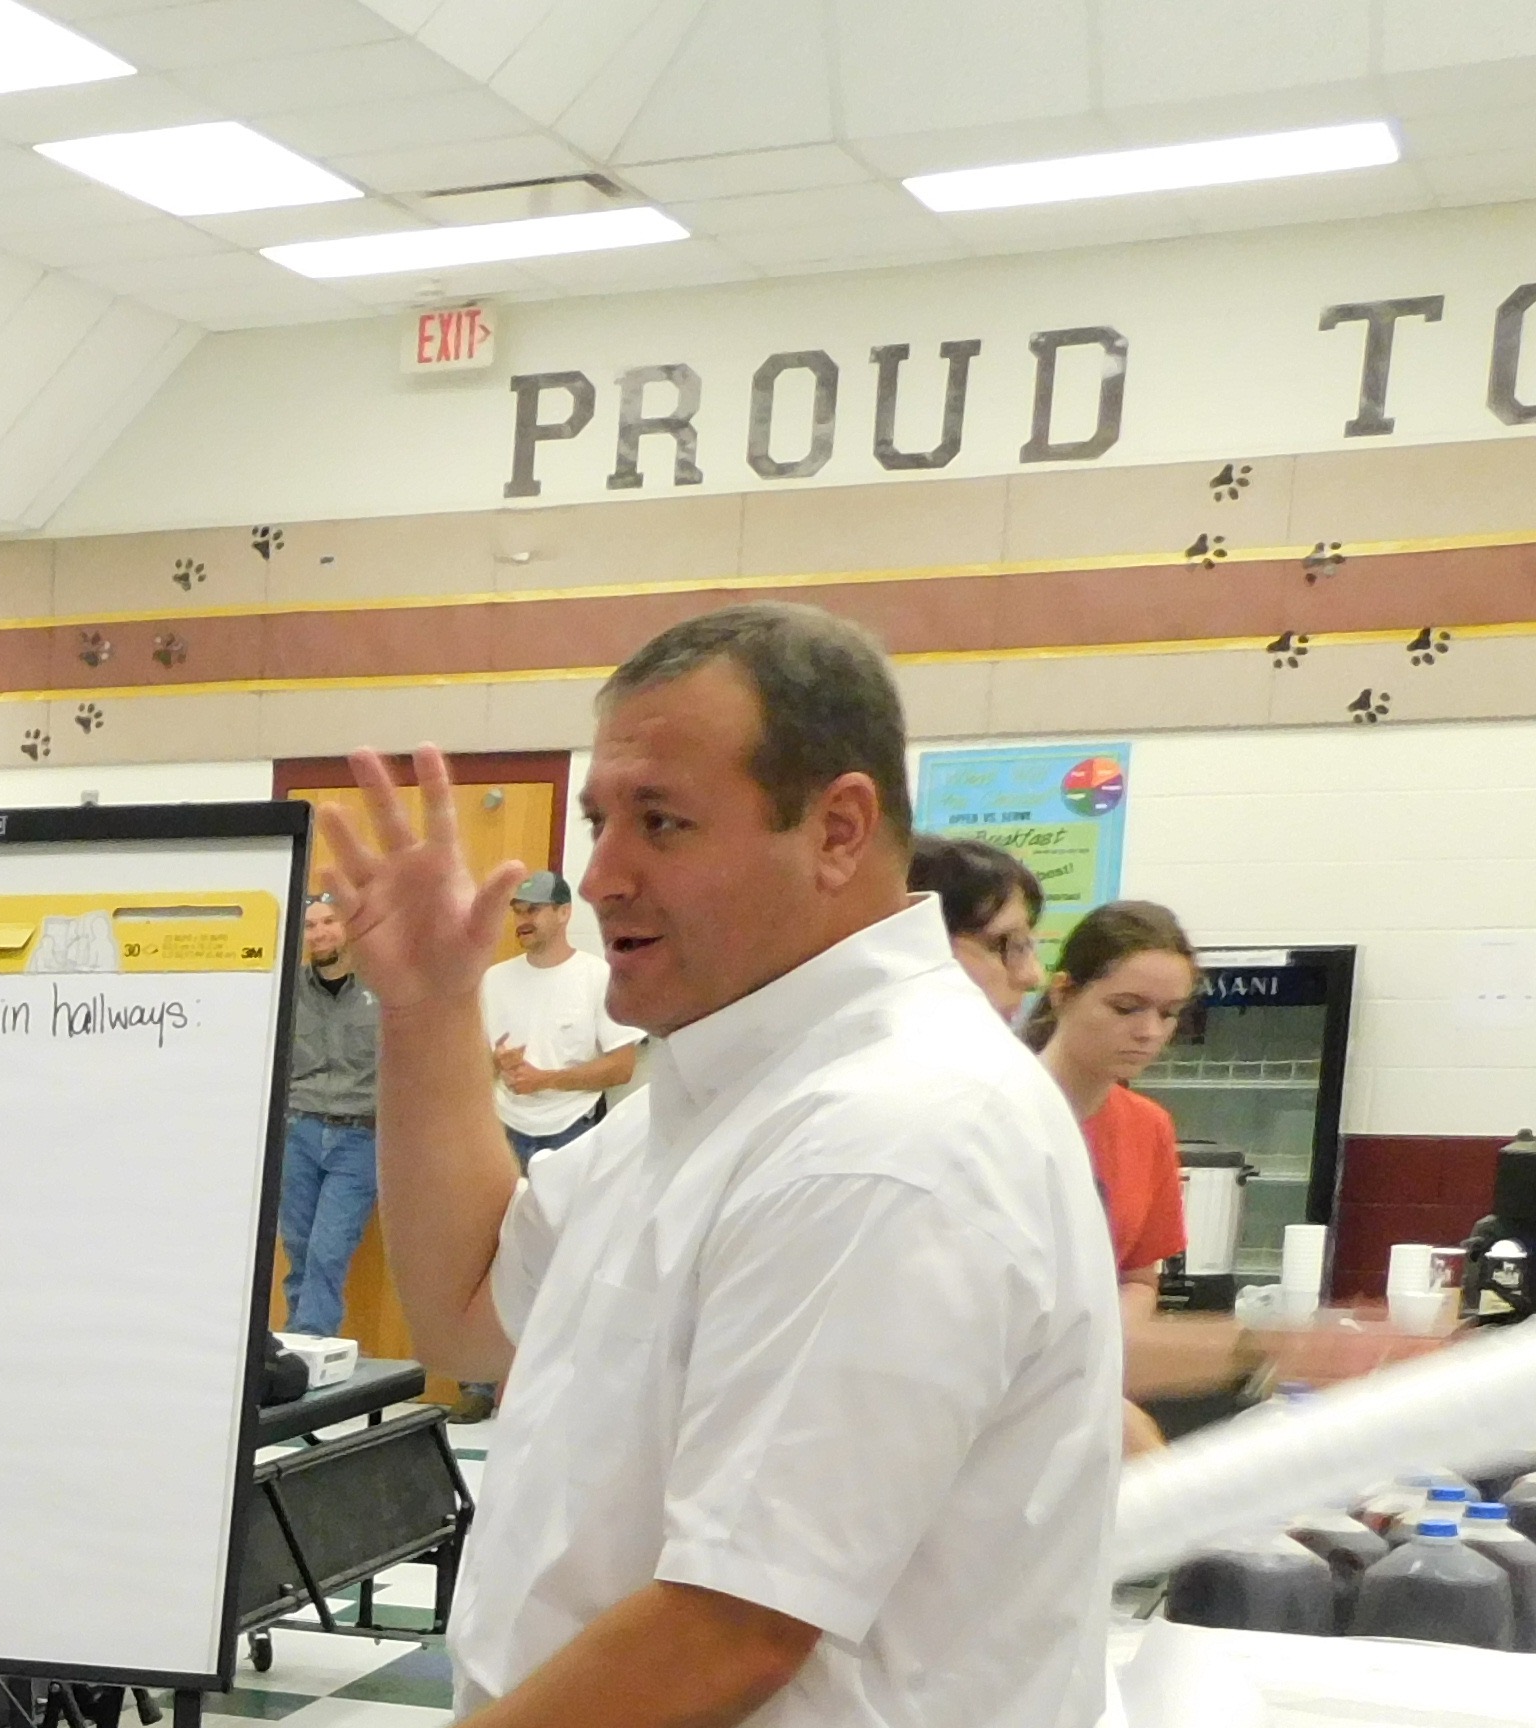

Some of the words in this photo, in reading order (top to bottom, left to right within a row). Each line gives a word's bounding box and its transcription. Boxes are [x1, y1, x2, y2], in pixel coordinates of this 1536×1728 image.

[417, 309, 481, 363] EXIT
[503, 325, 1128, 498] PROUD
[124, 943, 141, 957] 30
[241, 947, 264, 959] 3M
[1, 1000, 30, 1035] in
